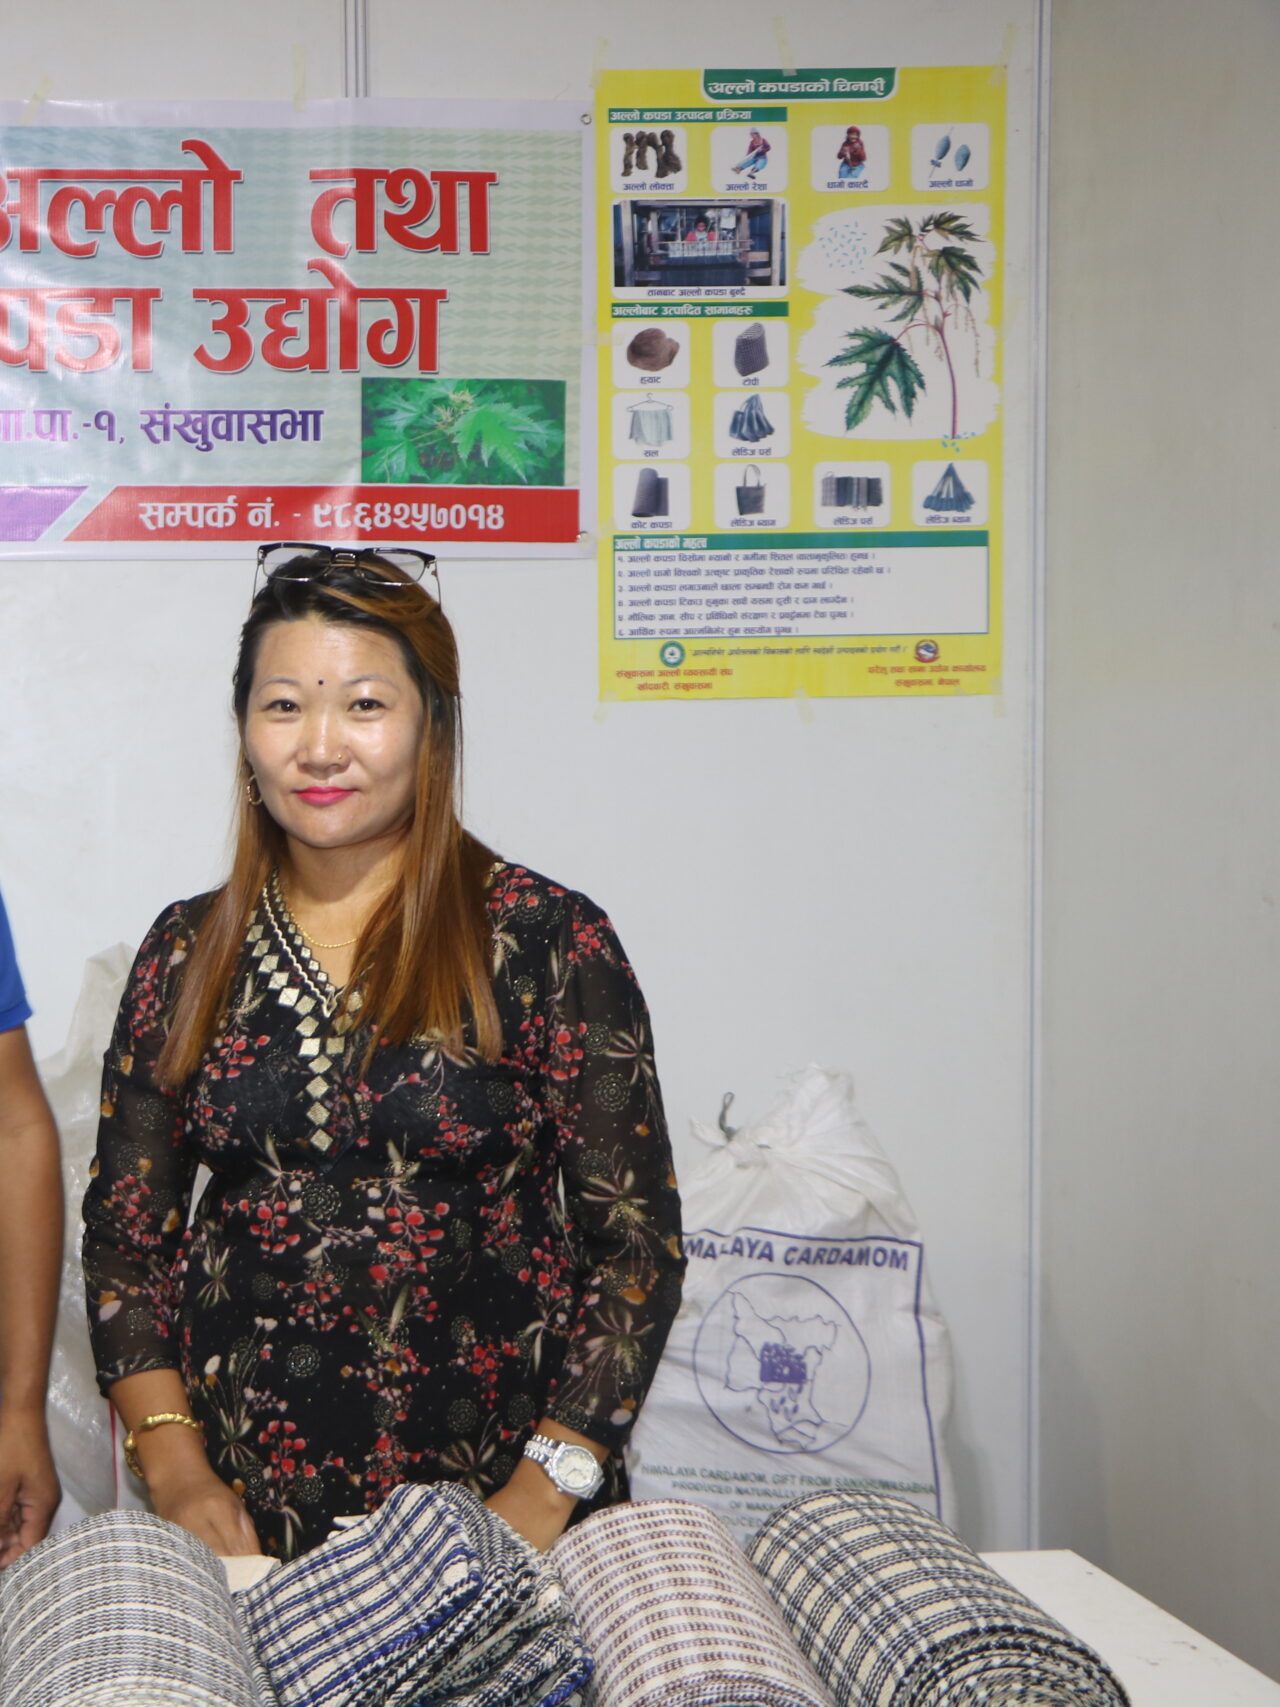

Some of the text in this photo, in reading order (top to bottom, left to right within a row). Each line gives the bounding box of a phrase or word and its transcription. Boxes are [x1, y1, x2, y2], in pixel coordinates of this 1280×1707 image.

[707, 79, 755, 95] अल्लो
[758, 78, 831, 94] कपडाको
[610, 109, 640, 121] अल्लो
[643, 110, 672, 121] कपडा
[675, 110, 713, 121] उत्पादन
[309, 167, 498, 259] तथा
[192, 258, 448, 375] उद्योग
[140, 402, 325, 453] संखुवासभा
[139, 495, 239, 531] सम्पर्क
[312, 502, 505, 532] ९८६४२५७०१४
[683, 1235, 909, 1272] MALAYA CARDAMOM
